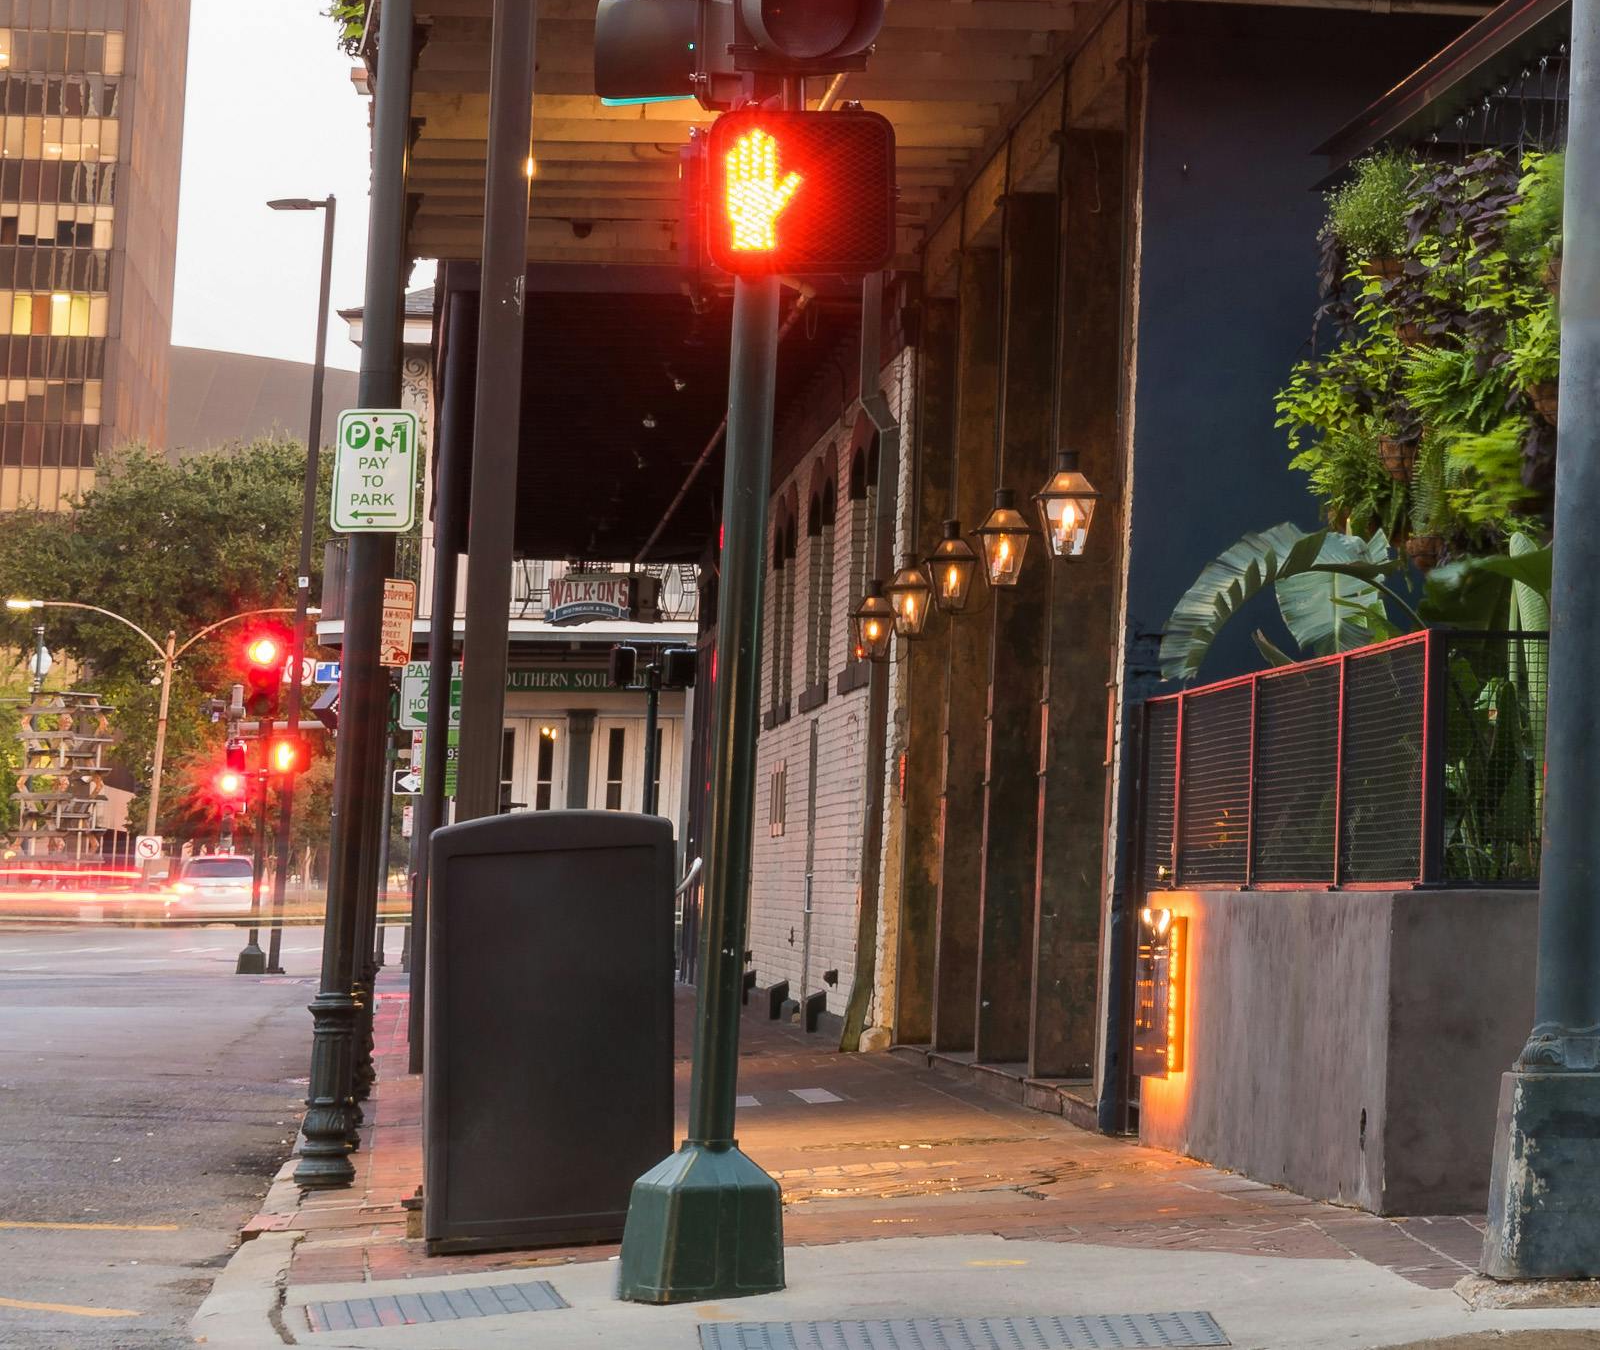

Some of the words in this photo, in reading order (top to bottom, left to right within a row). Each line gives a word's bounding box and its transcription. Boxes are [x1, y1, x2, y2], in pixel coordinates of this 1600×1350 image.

[350, 424, 366, 446] P
[358, 457, 390, 469] PAY
[361, 475, 384, 488] TO
[350, 493, 395, 506] PARK
[382, 620, 402, 628] RIDAY
[382, 630, 401, 638] TREET
[407, 664, 431, 677] PAY
[506, 672, 568, 687] OUTHERN
[409, 698, 429, 710] HO
